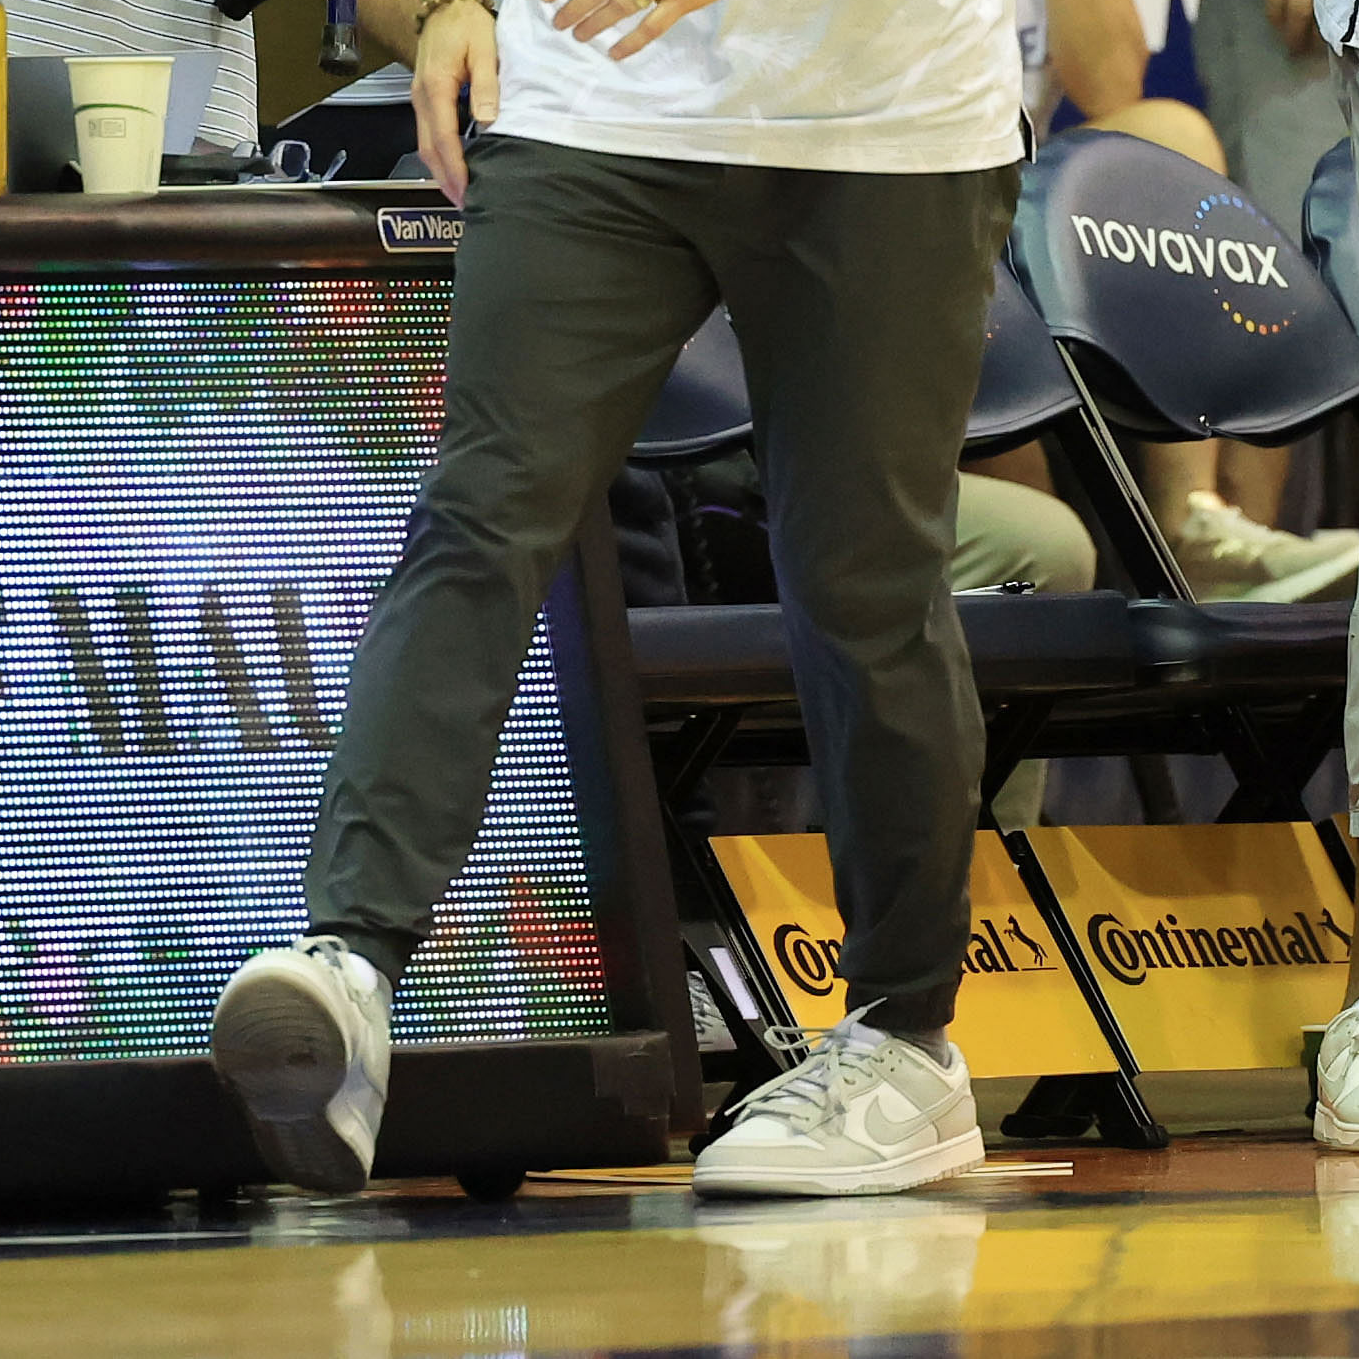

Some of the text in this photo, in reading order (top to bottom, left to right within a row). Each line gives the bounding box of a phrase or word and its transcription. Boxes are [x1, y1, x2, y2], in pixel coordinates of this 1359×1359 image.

[383, 215, 465, 247] Van Wag
[1071, 214, 1289, 289] novavax
[48, 579, 369, 760] MAU
[1087, 912, 1331, 986] Continental
